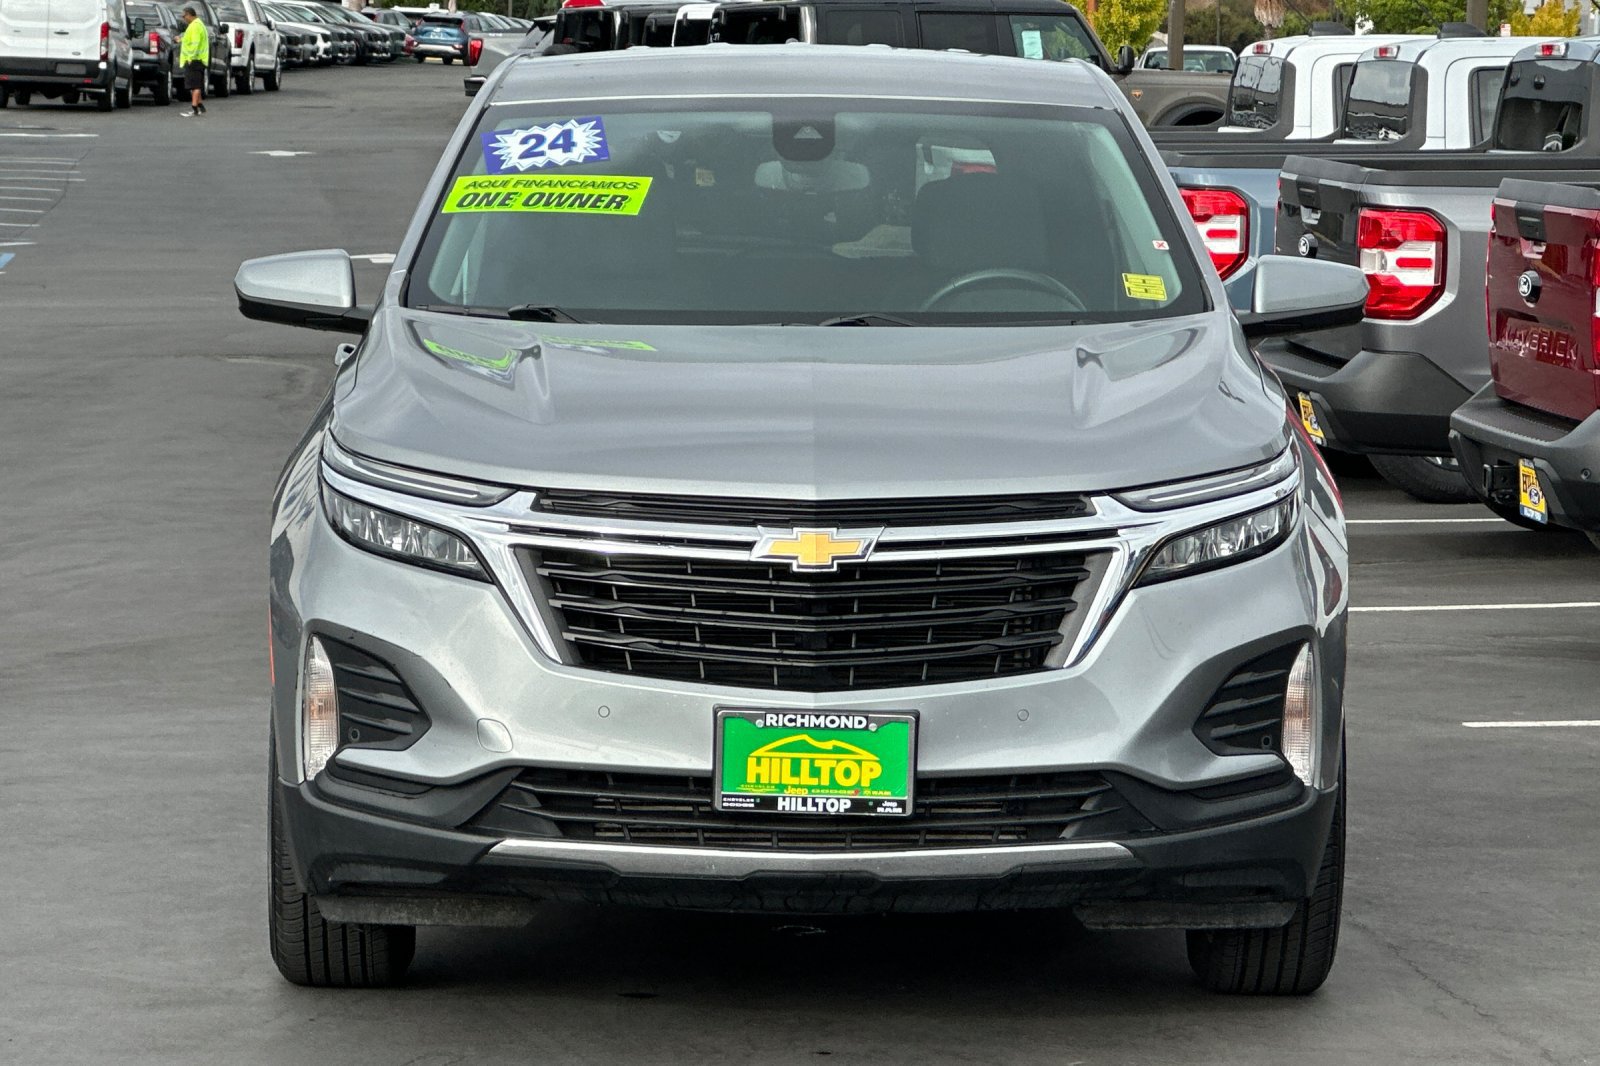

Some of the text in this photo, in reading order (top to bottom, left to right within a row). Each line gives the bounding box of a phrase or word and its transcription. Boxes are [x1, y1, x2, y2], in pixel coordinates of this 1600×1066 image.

[517, 128, 577, 160] 24
[463, 177, 641, 190] AQUÍ FINANCIAMOS
[456, 191, 631, 211] ONE OWNER
[766, 714, 867, 729] RICHMOND
[746, 756, 882, 787] HILLTOP
[784, 785, 809, 796] Jeep
[777, 797, 851, 812] HILLTOP
